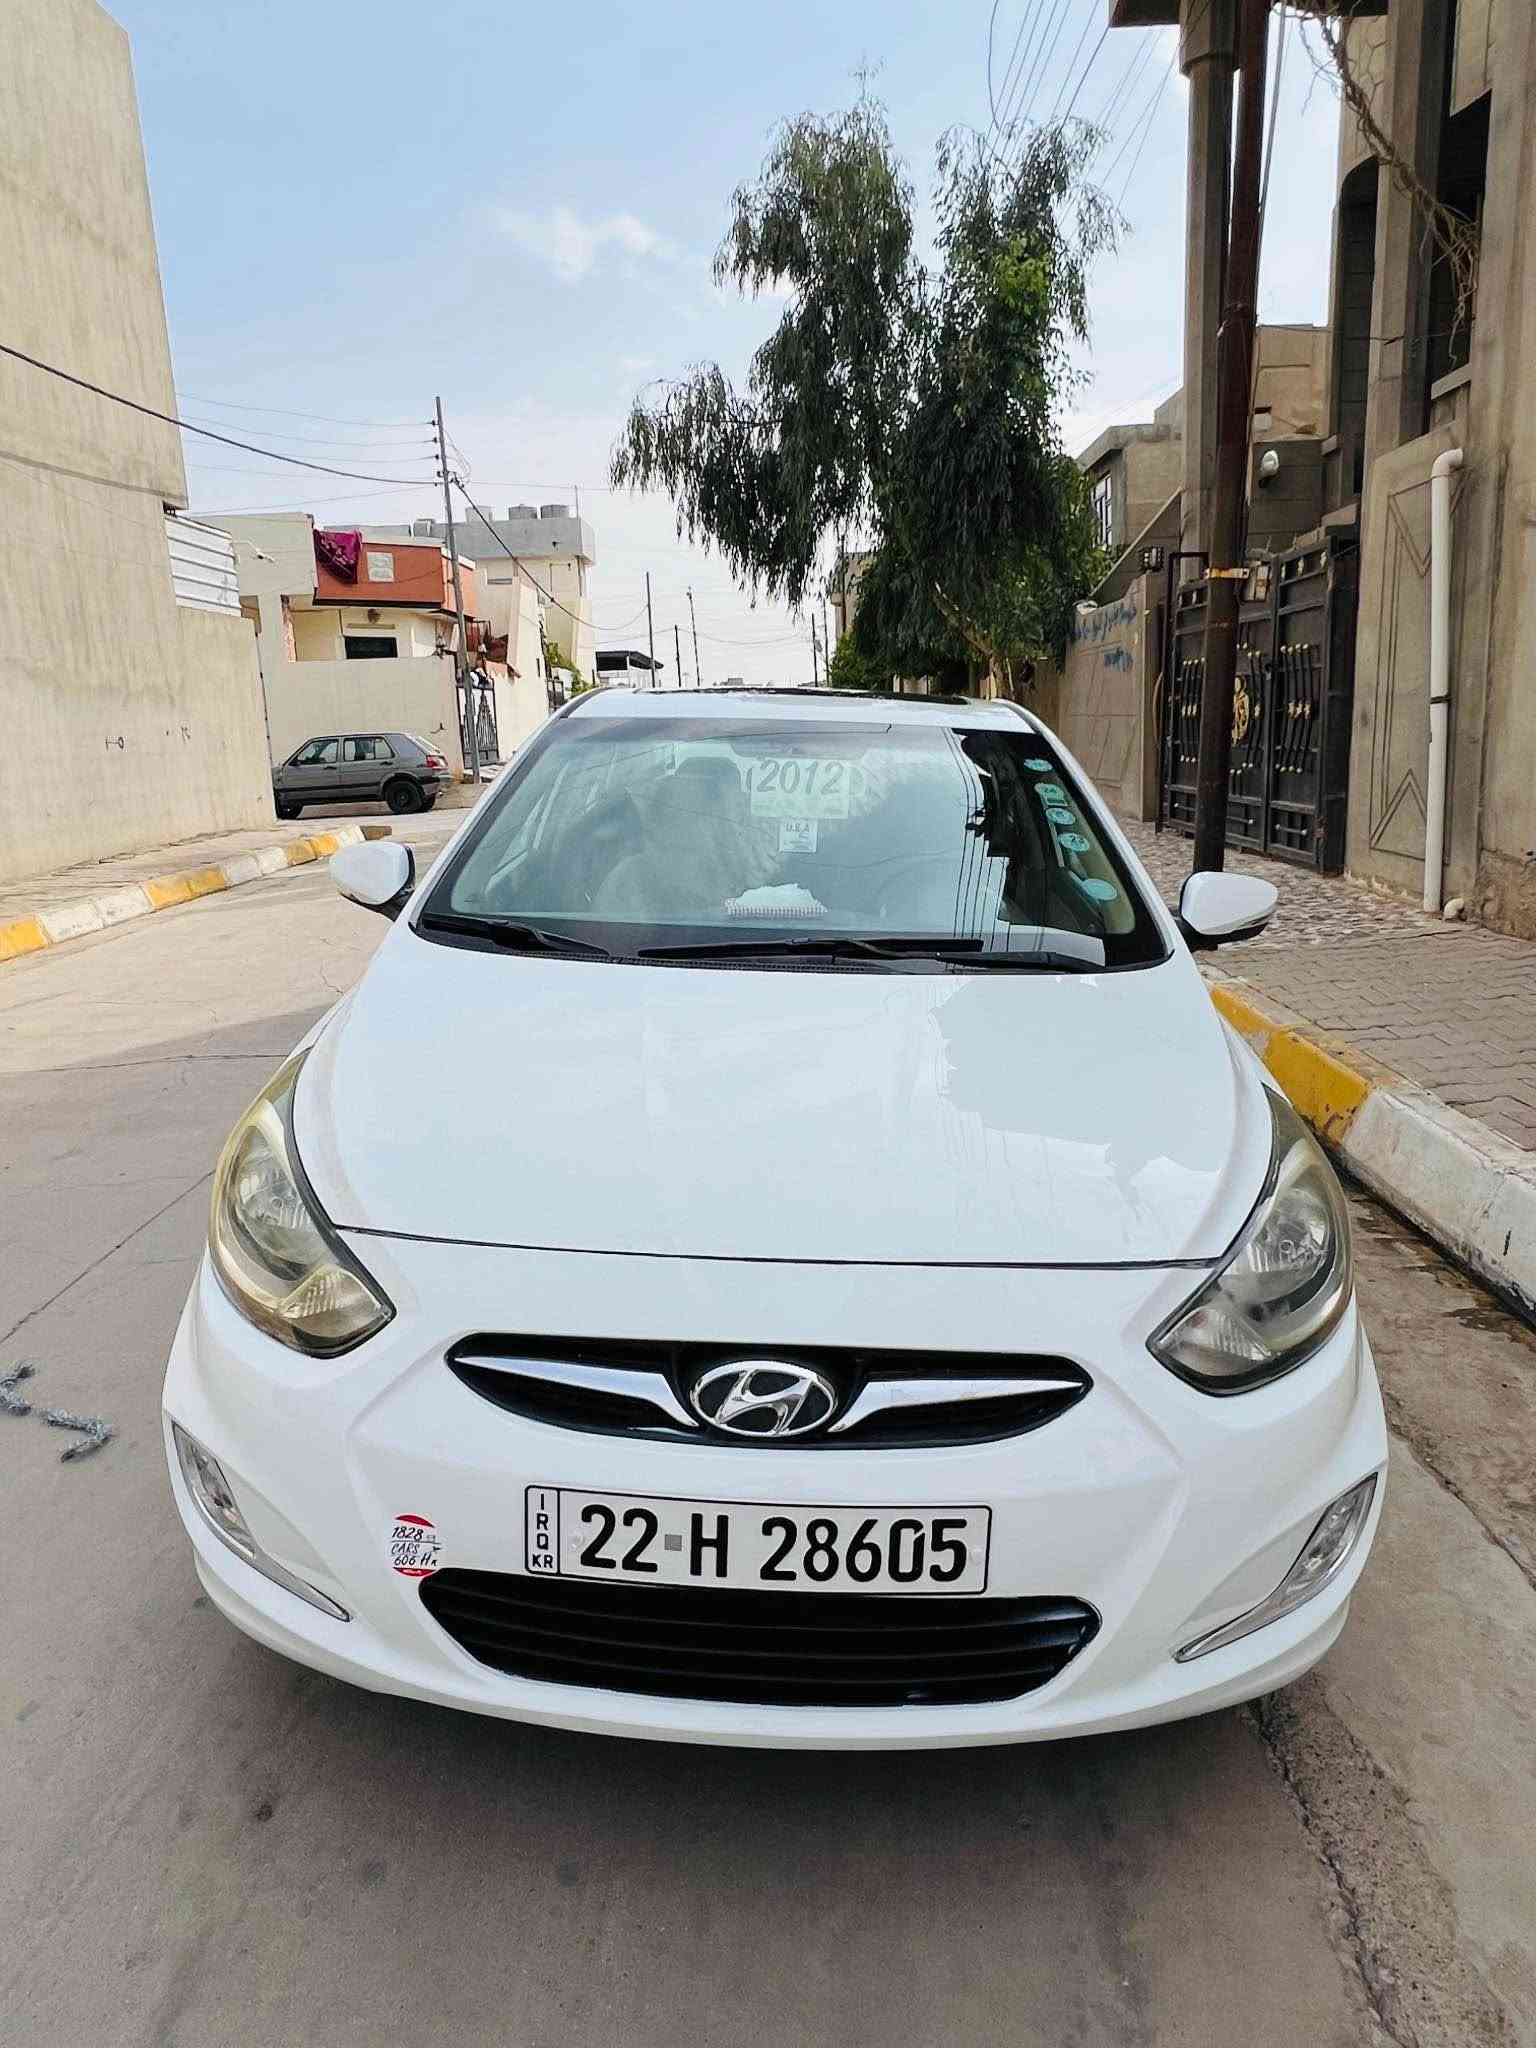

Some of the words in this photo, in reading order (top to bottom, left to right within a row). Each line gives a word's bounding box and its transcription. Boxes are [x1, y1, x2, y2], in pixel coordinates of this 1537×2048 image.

[756, 759, 844, 795] 2012
[391, 1526, 424, 1542] 1828
[579, 1503, 659, 1573] 22
[690, 1512, 729, 1578] H
[759, 1516, 968, 1583] 28605
[532, 1553, 554, 1569] KR
